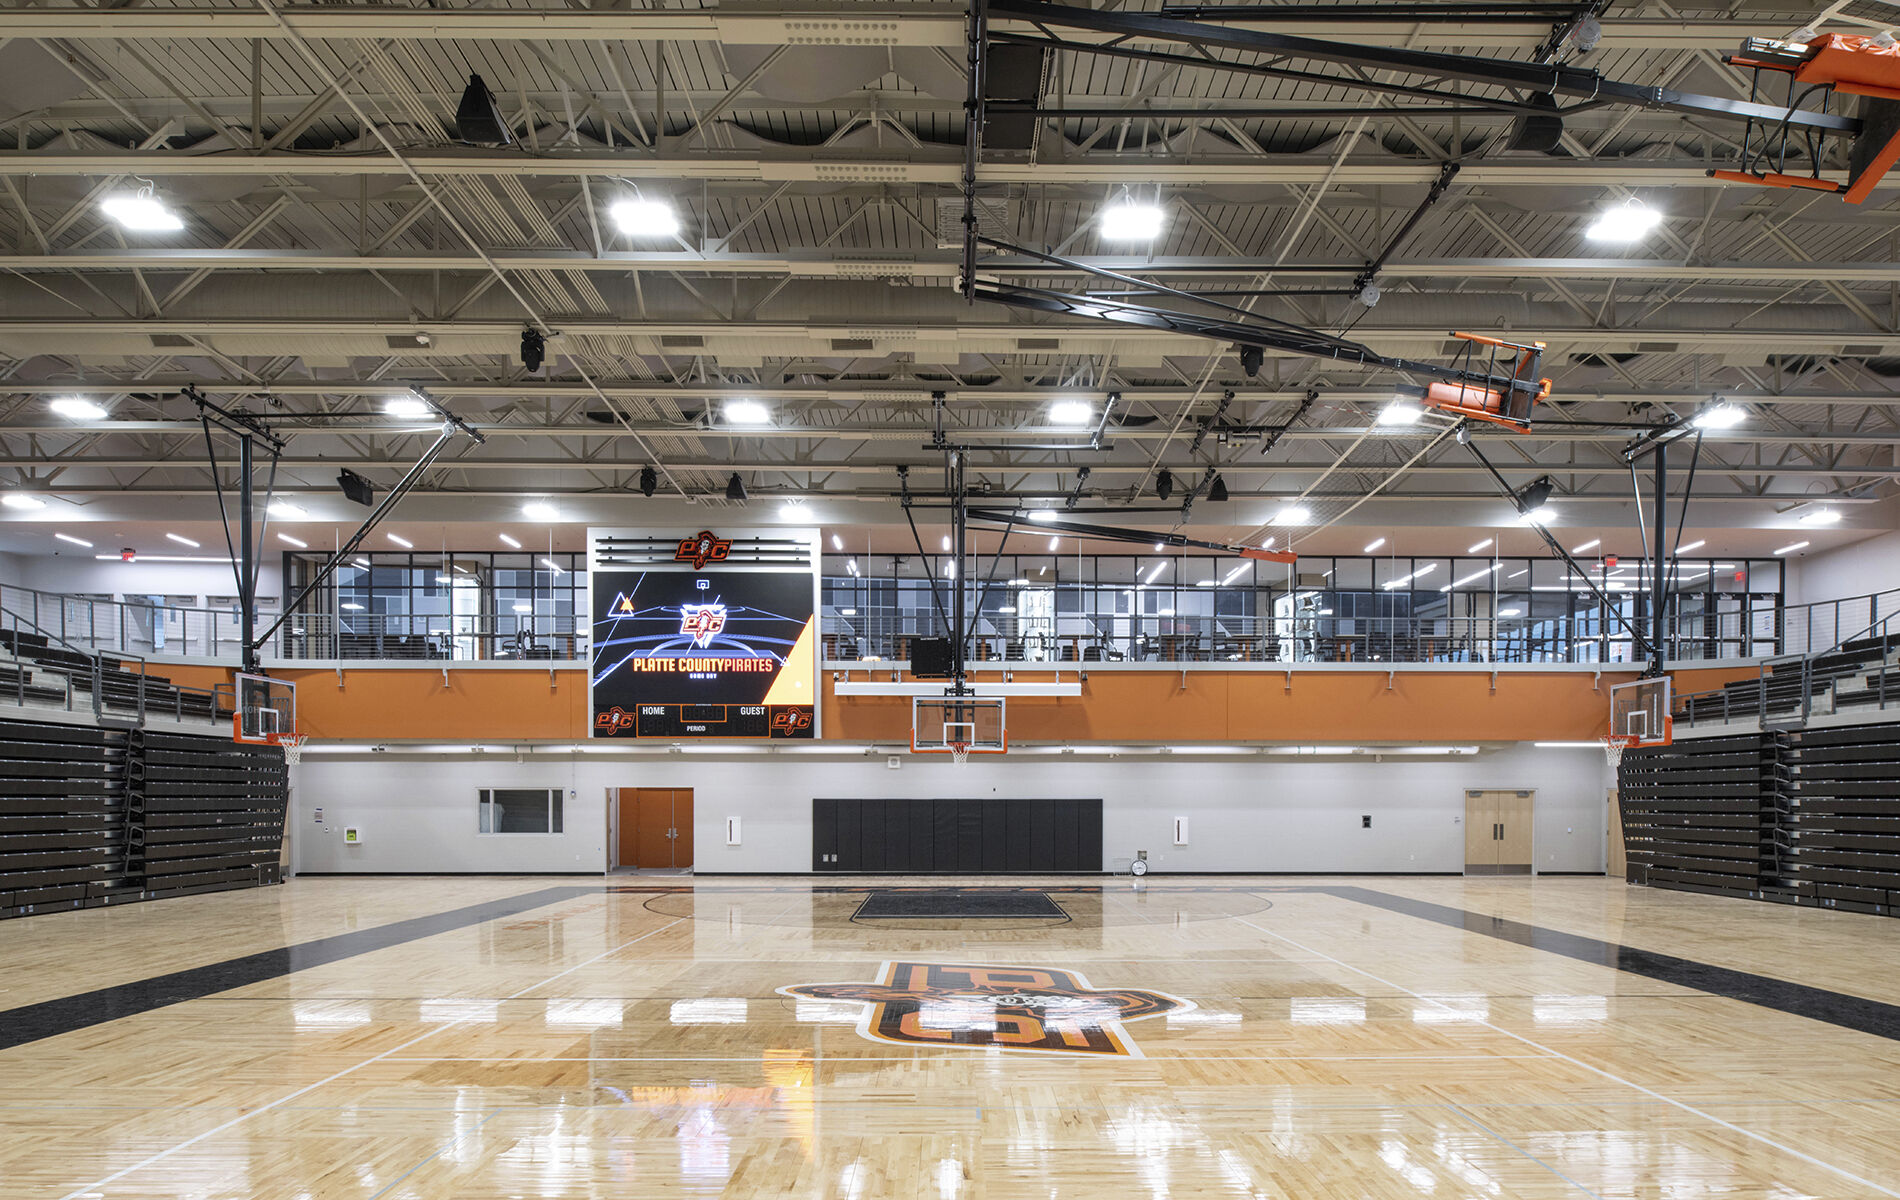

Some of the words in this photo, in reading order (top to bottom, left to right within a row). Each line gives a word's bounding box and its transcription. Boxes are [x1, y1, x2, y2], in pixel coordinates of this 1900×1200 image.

[633, 658, 676, 672] PLATTE
[642, 706, 665, 715] HOME
[740, 706, 765, 715] GUEST
